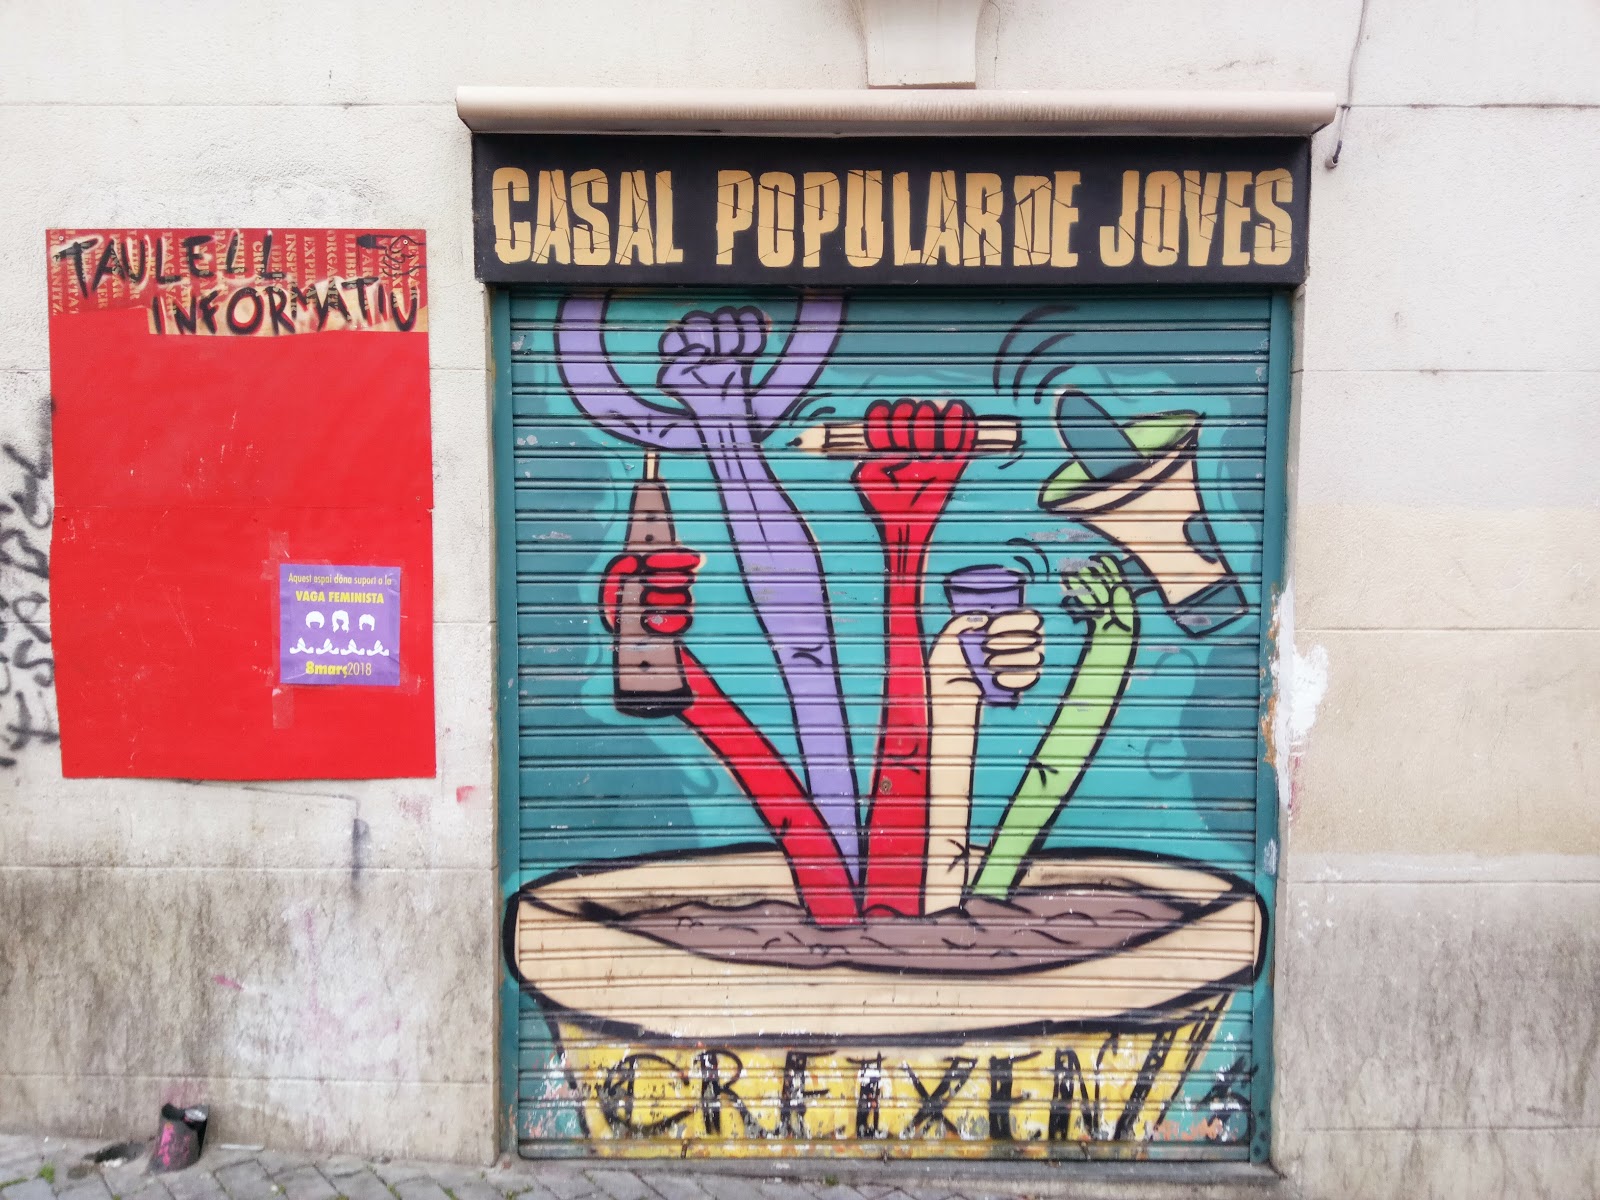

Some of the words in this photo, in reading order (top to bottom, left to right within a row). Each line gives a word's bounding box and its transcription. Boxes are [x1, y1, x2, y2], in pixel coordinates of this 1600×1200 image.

[492, 166, 684, 266] CASAL
[716, 169, 1004, 268] POPULAR
[1013, 170, 1082, 268] DE
[1099, 167, 1294, 268] JOVES
[54, 231, 287, 298] TAULELL
[288, 572, 312, 584] Aquest
[295, 590, 326, 603] VAGA
[328, 591, 385, 604] FEMINISTA
